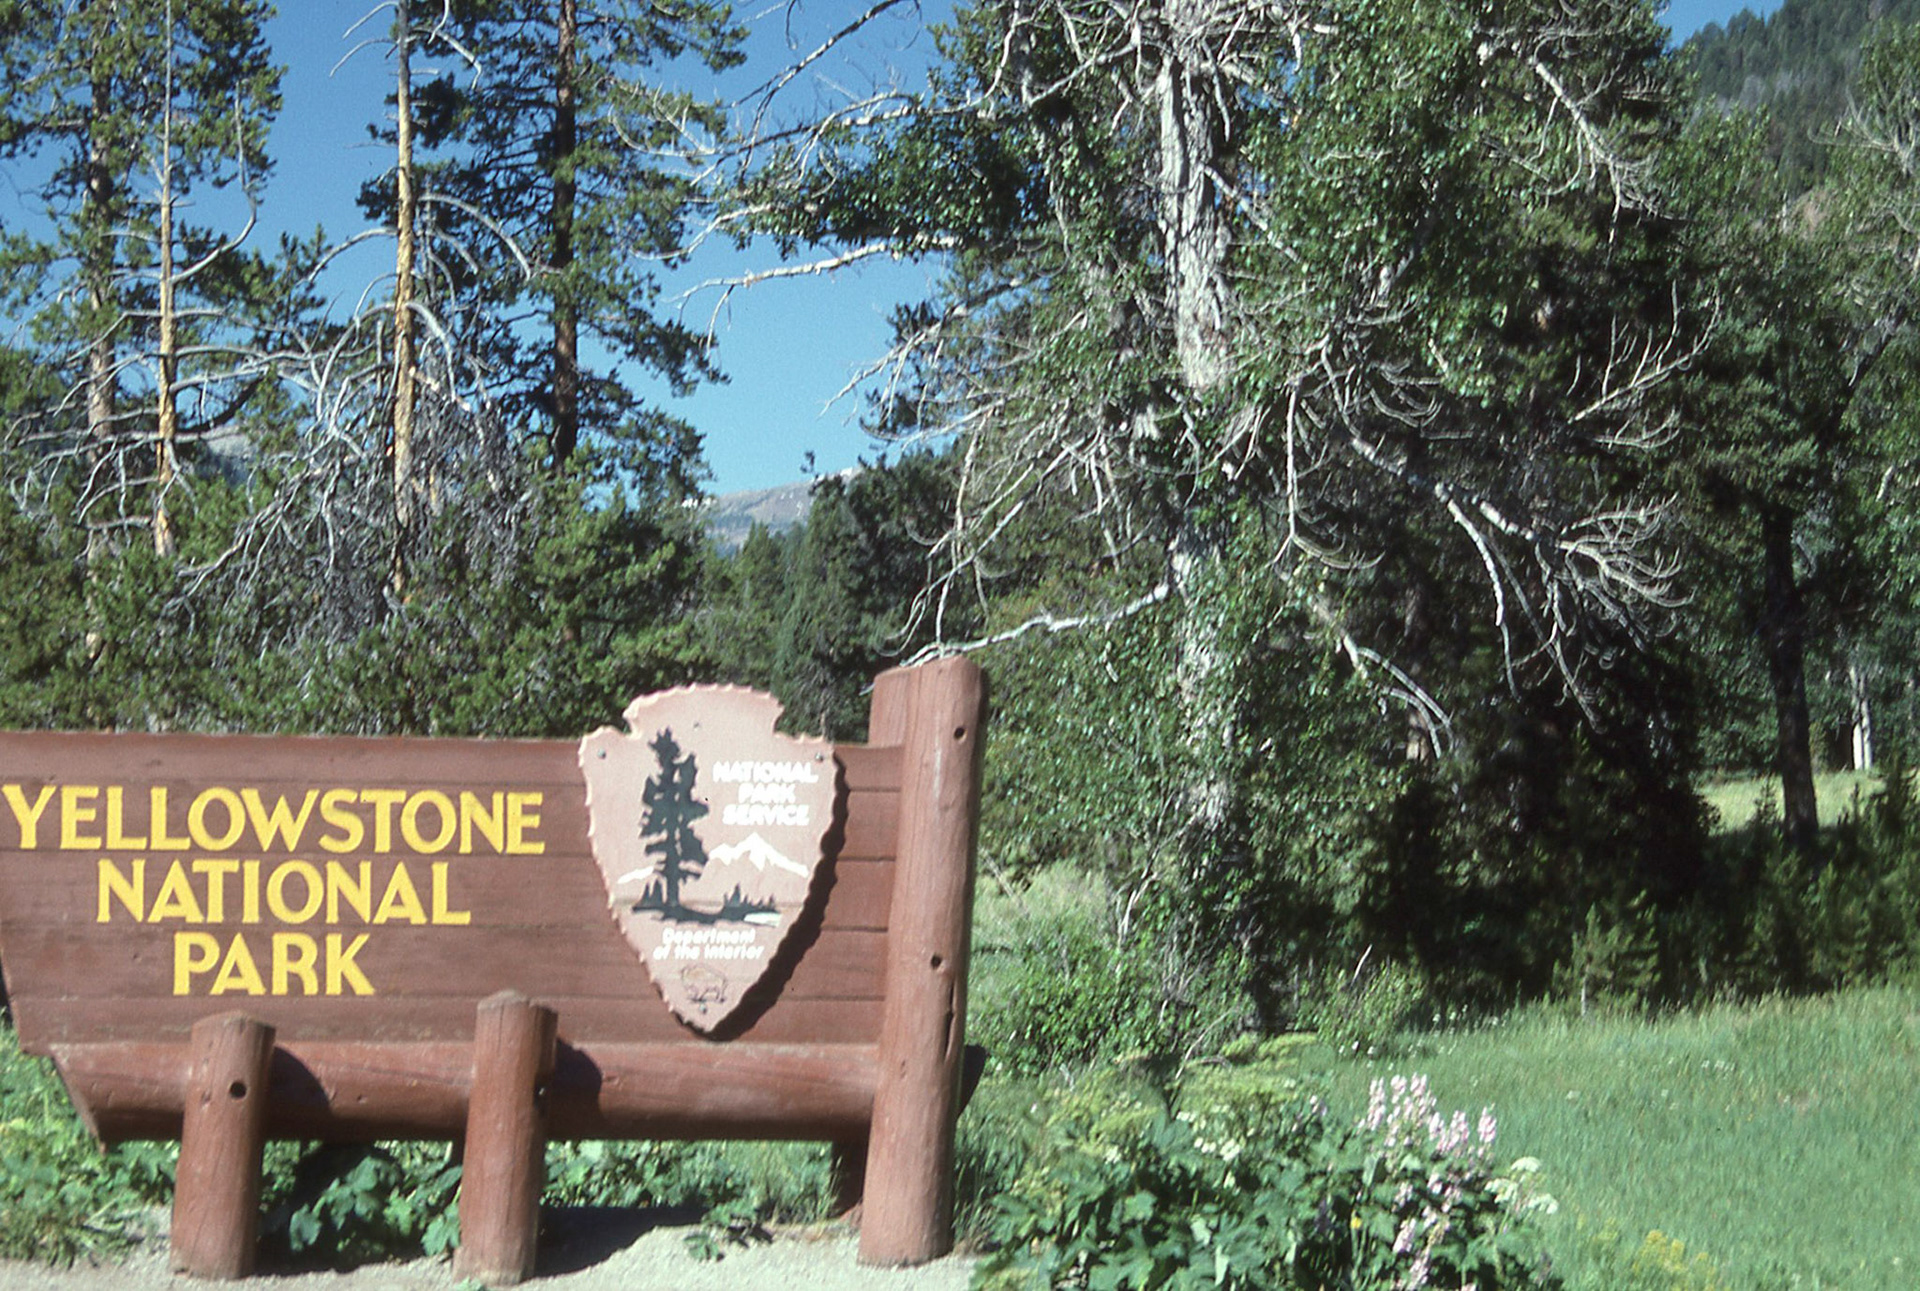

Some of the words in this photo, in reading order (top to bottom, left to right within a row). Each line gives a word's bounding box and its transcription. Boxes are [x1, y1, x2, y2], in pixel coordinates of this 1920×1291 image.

[712, 760, 819, 783] NATIONAL
[738, 782, 796, 804] PARK
[2, 784, 545, 854] YELLOWSTONE
[722, 803, 810, 826] SERVICE
[97, 858, 471, 925] NATIONAL
[662, 927, 756, 947] Department
[173, 931, 376, 996] PARK
[653, 945, 671, 960] of
[674, 944, 700, 960] the
